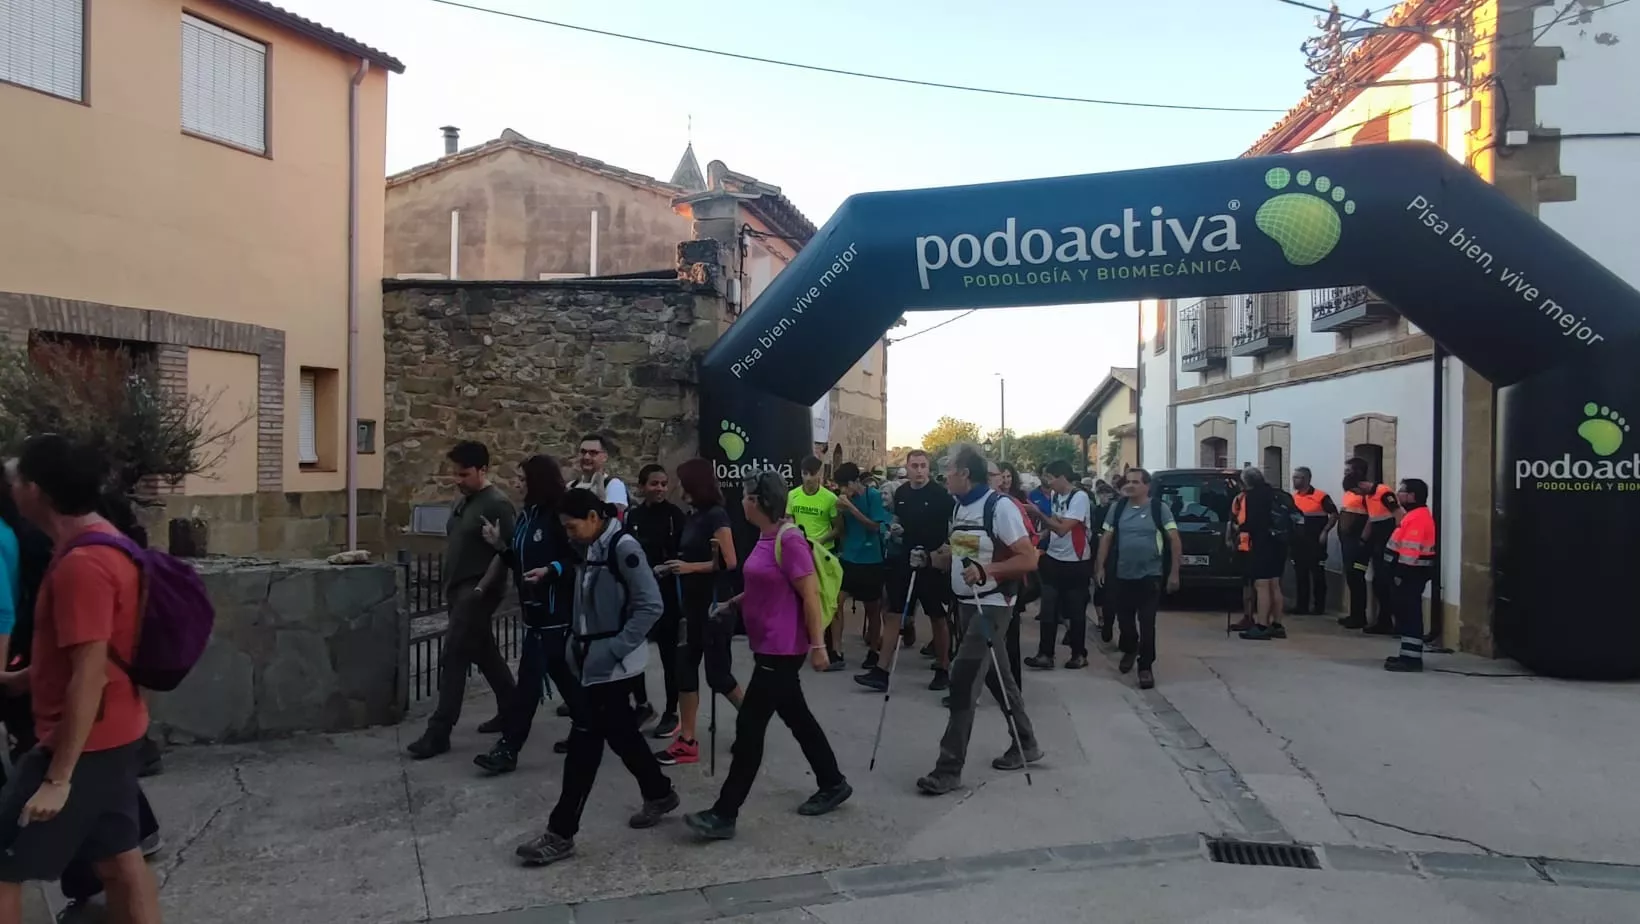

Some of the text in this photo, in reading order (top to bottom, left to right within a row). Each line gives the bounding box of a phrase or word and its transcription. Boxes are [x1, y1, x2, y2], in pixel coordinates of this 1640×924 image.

[963, 258, 1241, 288] PODOLOGÍA Y BIOMECÁNICA
[1407, 195, 1604, 346] Pisa bien, vive mejor
[730, 242, 859, 379] Pisa bien, vive mejor
[1515, 453, 1640, 489] podoact
[1536, 481, 1602, 491] PODOLOGÍA
[1606, 482, 1613, 491] Y
